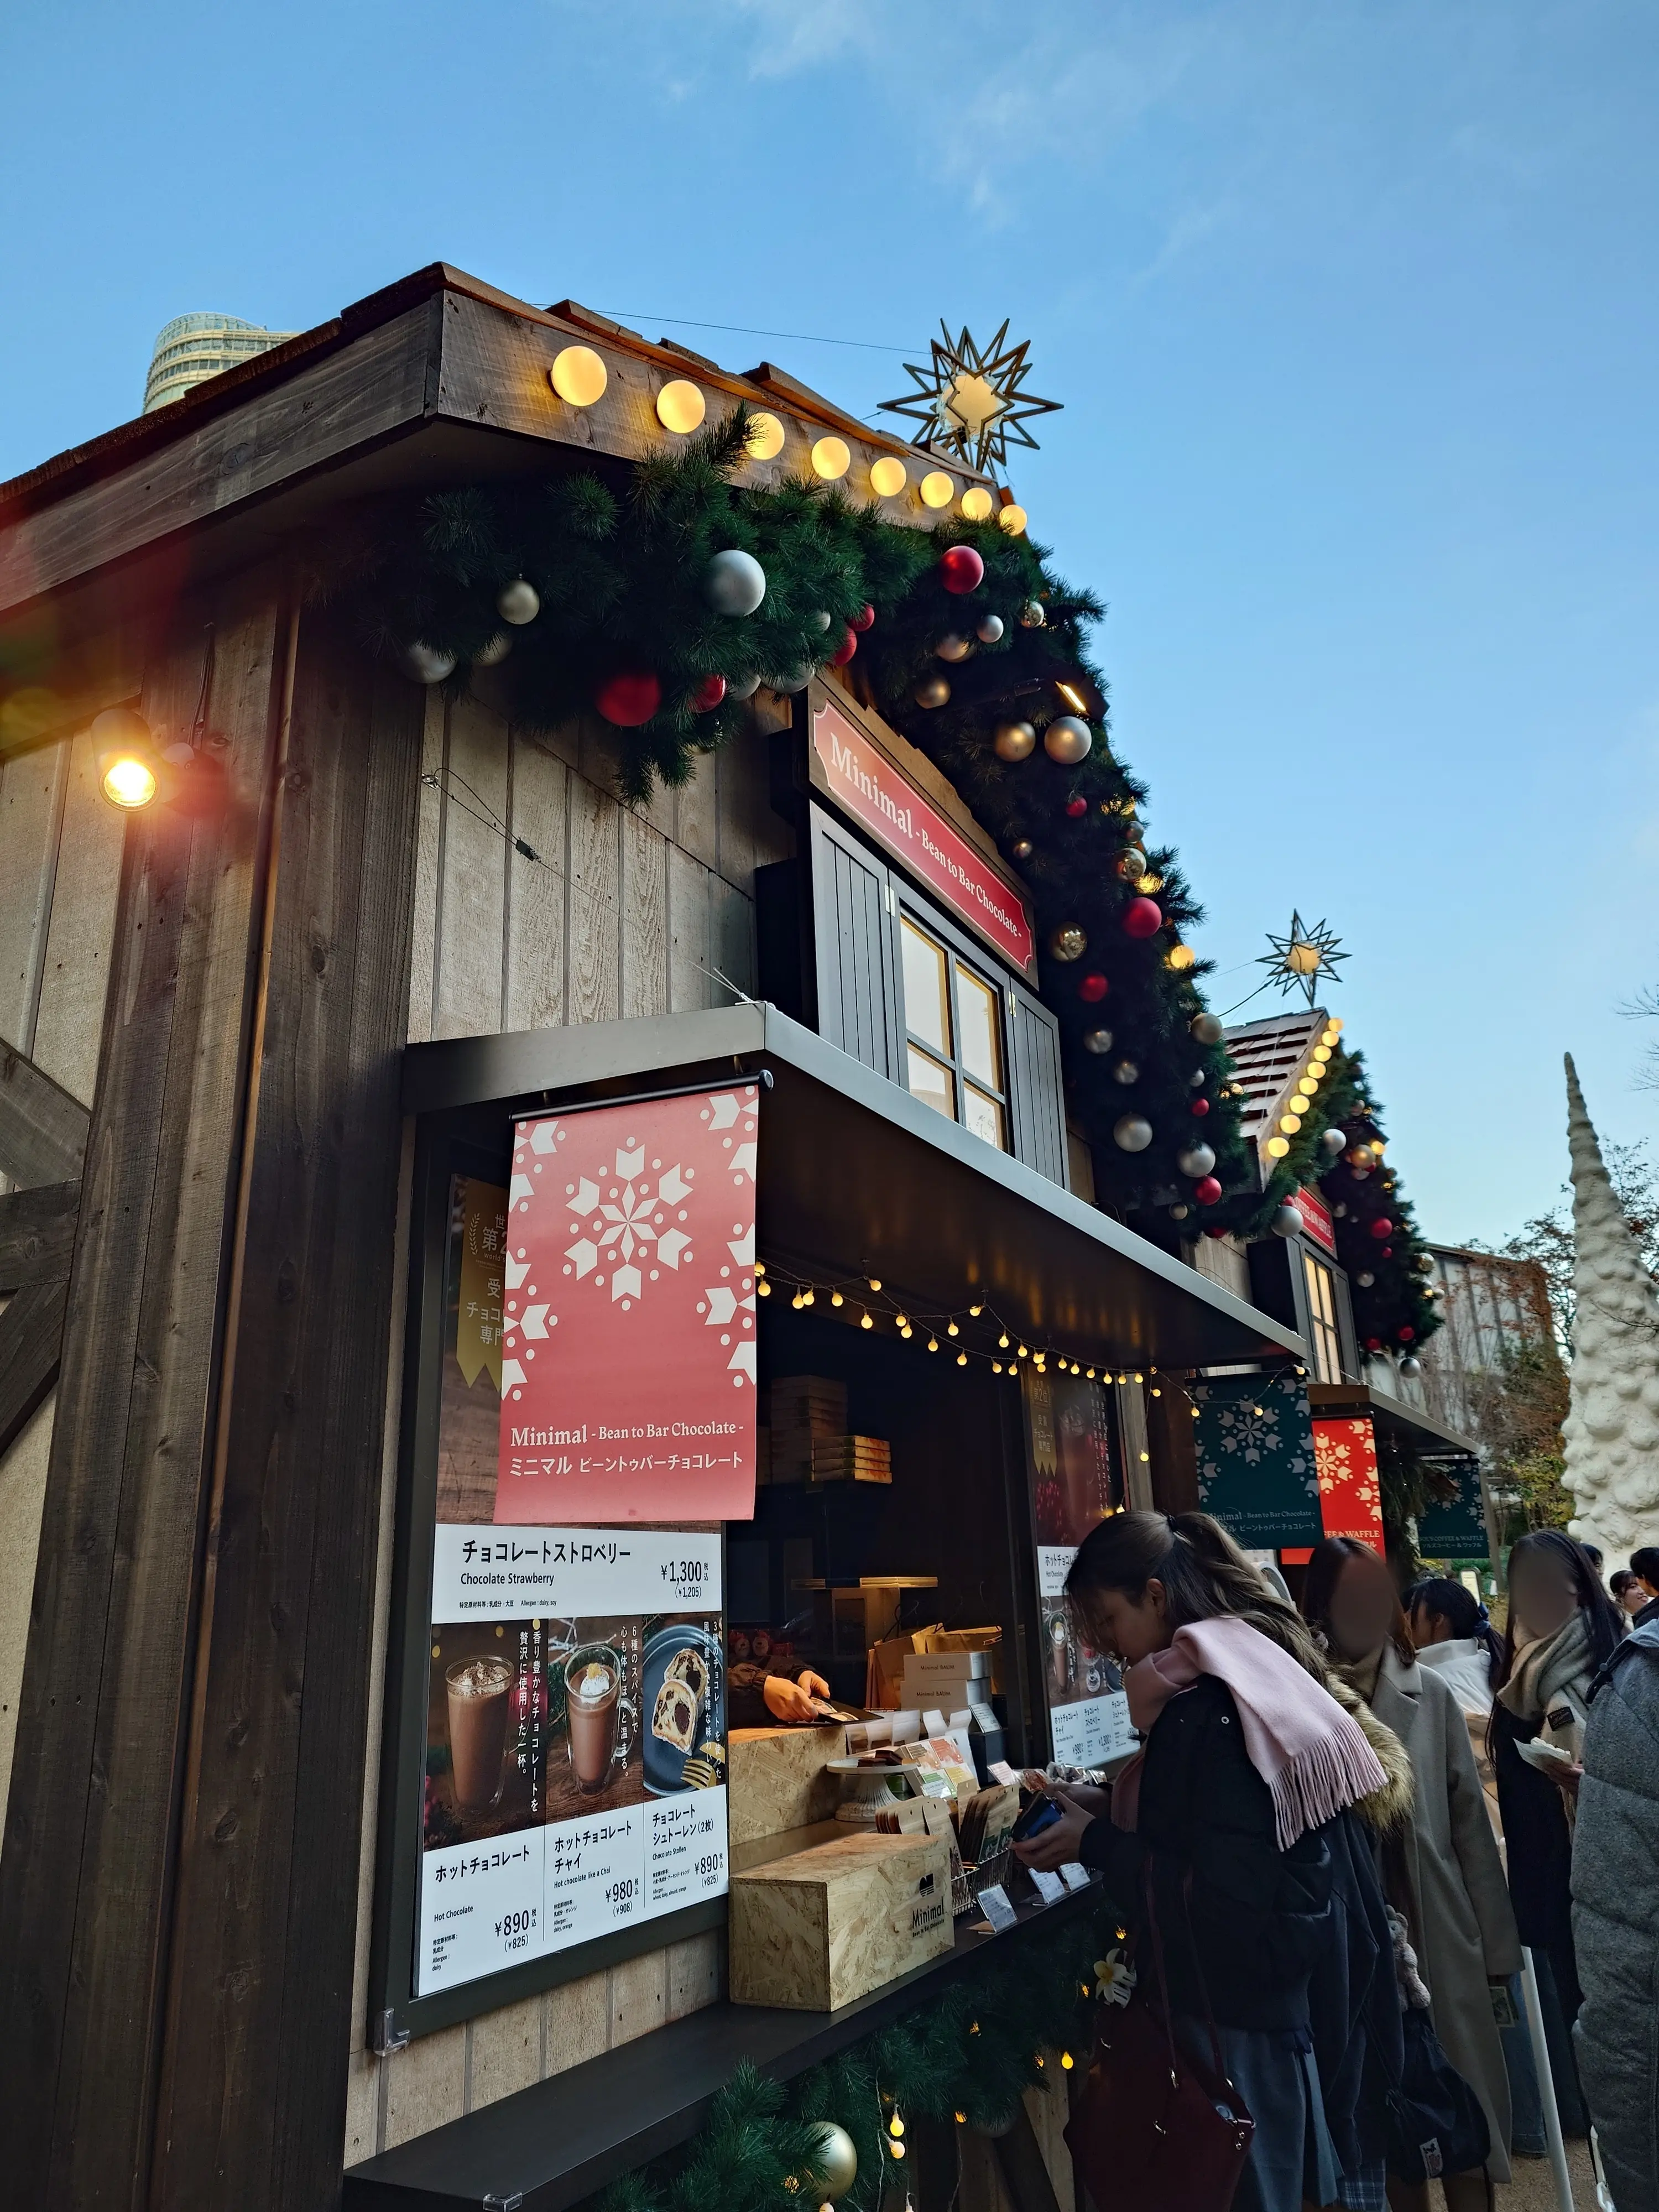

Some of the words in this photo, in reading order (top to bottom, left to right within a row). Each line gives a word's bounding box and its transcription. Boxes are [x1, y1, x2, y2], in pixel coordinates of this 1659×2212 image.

[830, 732, 913, 839] Minimal
[947, 857, 958, 878] to
[958, 865, 975, 896] Bar
[510, 1424, 587, 1447] Minimal
[631, 1426, 644, 1438] to
[646, 1424, 669, 1438] Bar
[509, 1456, 573, 1477] ミニマル
[579, 1451, 743, 1473] ビーントゥバーチョコレート
[1344, 1530, 1381, 1538] WAFFLE
[462, 1540, 631, 1564] チョコレートストロベリー
[460, 1572, 505, 1585] Chocolate
[508, 1573, 555, 1587] Strawberry
[660, 1561, 702, 1586] ¥1,300
[675, 1585, 702, 1600] (¥1,205)
[517, 1631, 529, 1774] 贅沢に使用した一杯。
[713, 1621, 722, 1779] 3種のチョコレートを使った
[530, 1631, 541, 1812] 香り豊かなチョコレートを
[653, 1803, 695, 1828] チョコレート
[555, 1820, 632, 1853] ホットチョコレート
[435, 1845, 530, 1883] ホットチョコレート
[555, 1852, 581, 1874] チャイ
[653, 1849, 672, 1860] Chocolate
[672, 1845, 686, 1855] Stollen
[694, 1853, 718, 1875] ¥890
[554, 1880, 563, 1888] Hot
[564, 1874, 586, 1886] chocolate
[601, 1866, 611, 1876] Chai
[701, 1873, 718, 1888] (¥825)
[605, 1879, 633, 1903] ¥980
[434, 1913, 445, 1922] Hot
[446, 1906, 474, 1919] Chocolate
[613, 1900, 633, 1917] (¥908)
[912, 1896, 945, 1929] Minimal
[494, 1910, 530, 1937] ¥890
[504, 1933, 529, 1953] (¥825)
